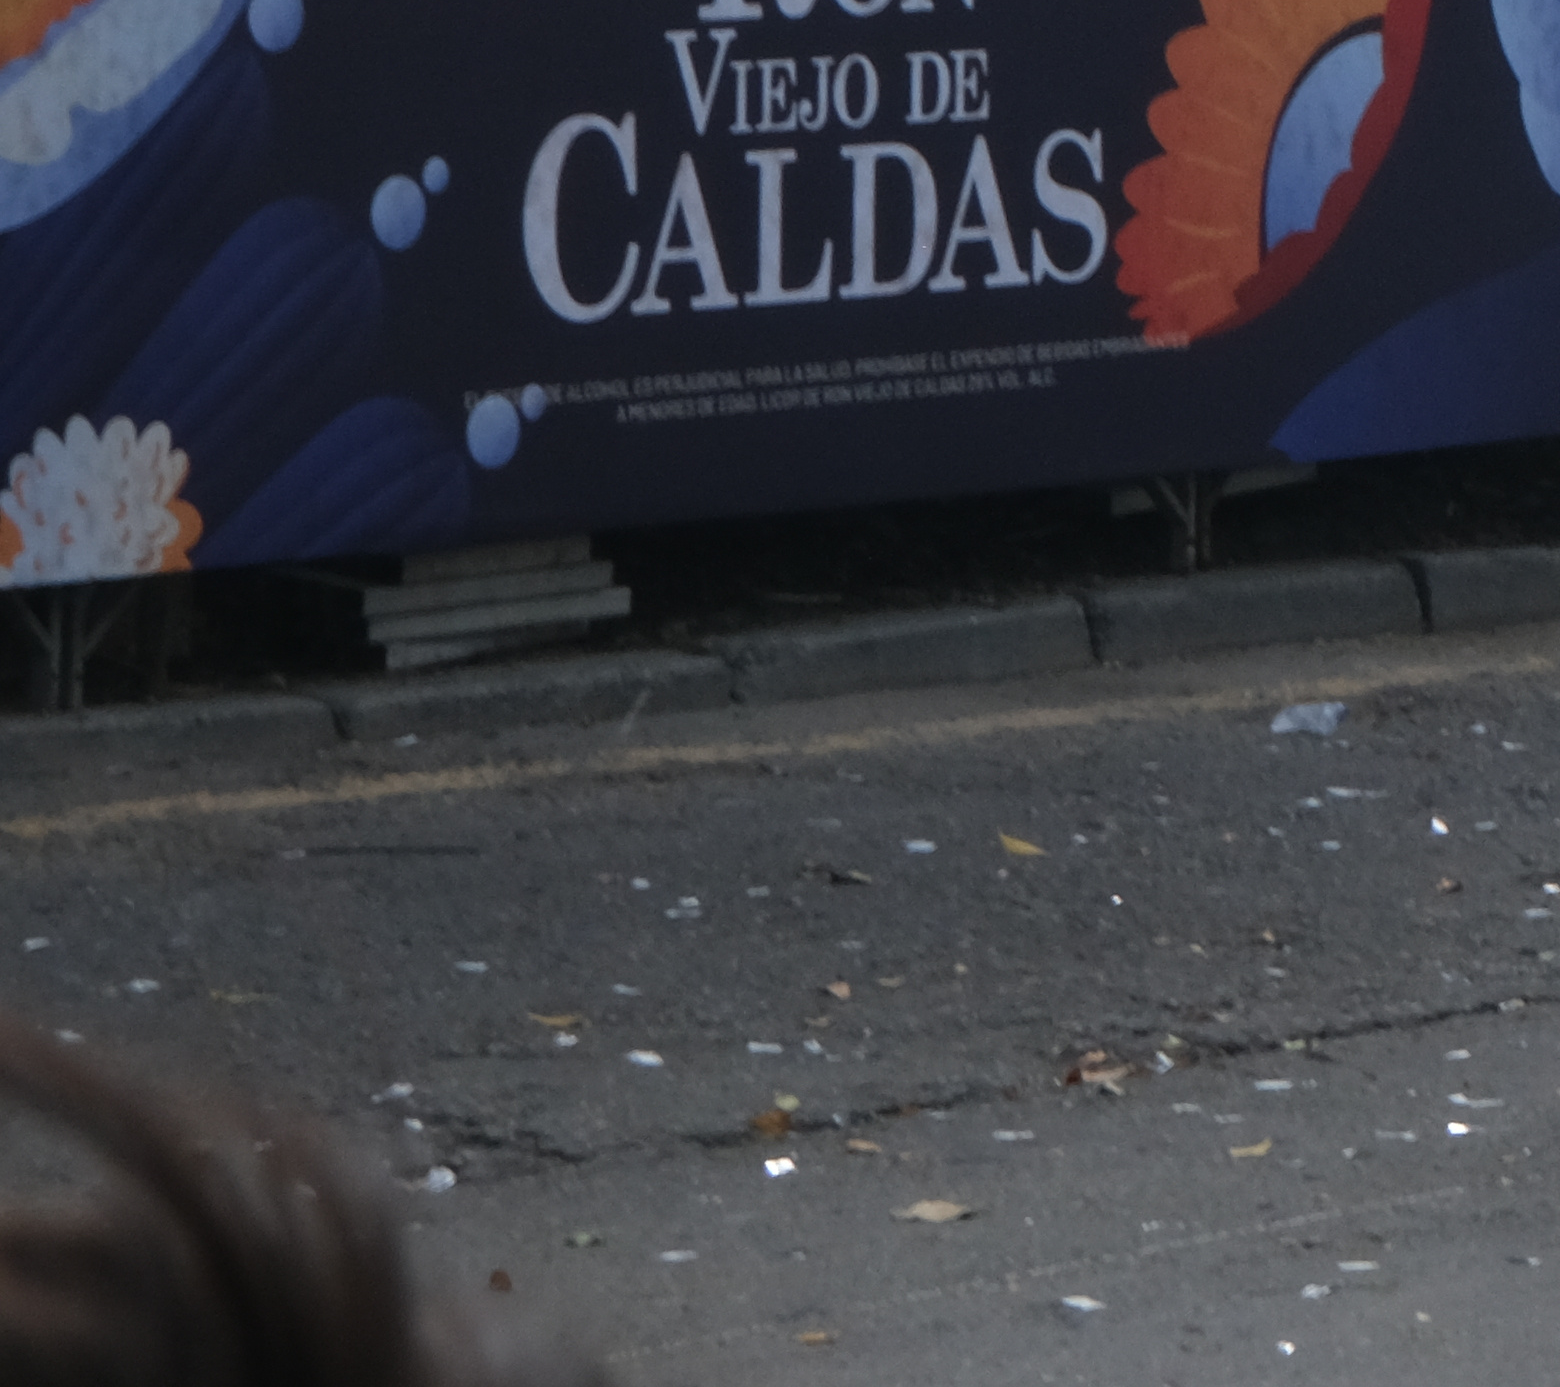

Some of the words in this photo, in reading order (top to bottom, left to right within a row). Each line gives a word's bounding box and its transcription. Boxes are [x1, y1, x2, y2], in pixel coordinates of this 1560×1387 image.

[665, 27, 880, 138] VIEJO
[904, 49, 992, 123] DE
[520, 112, 1110, 324] CALDAS
